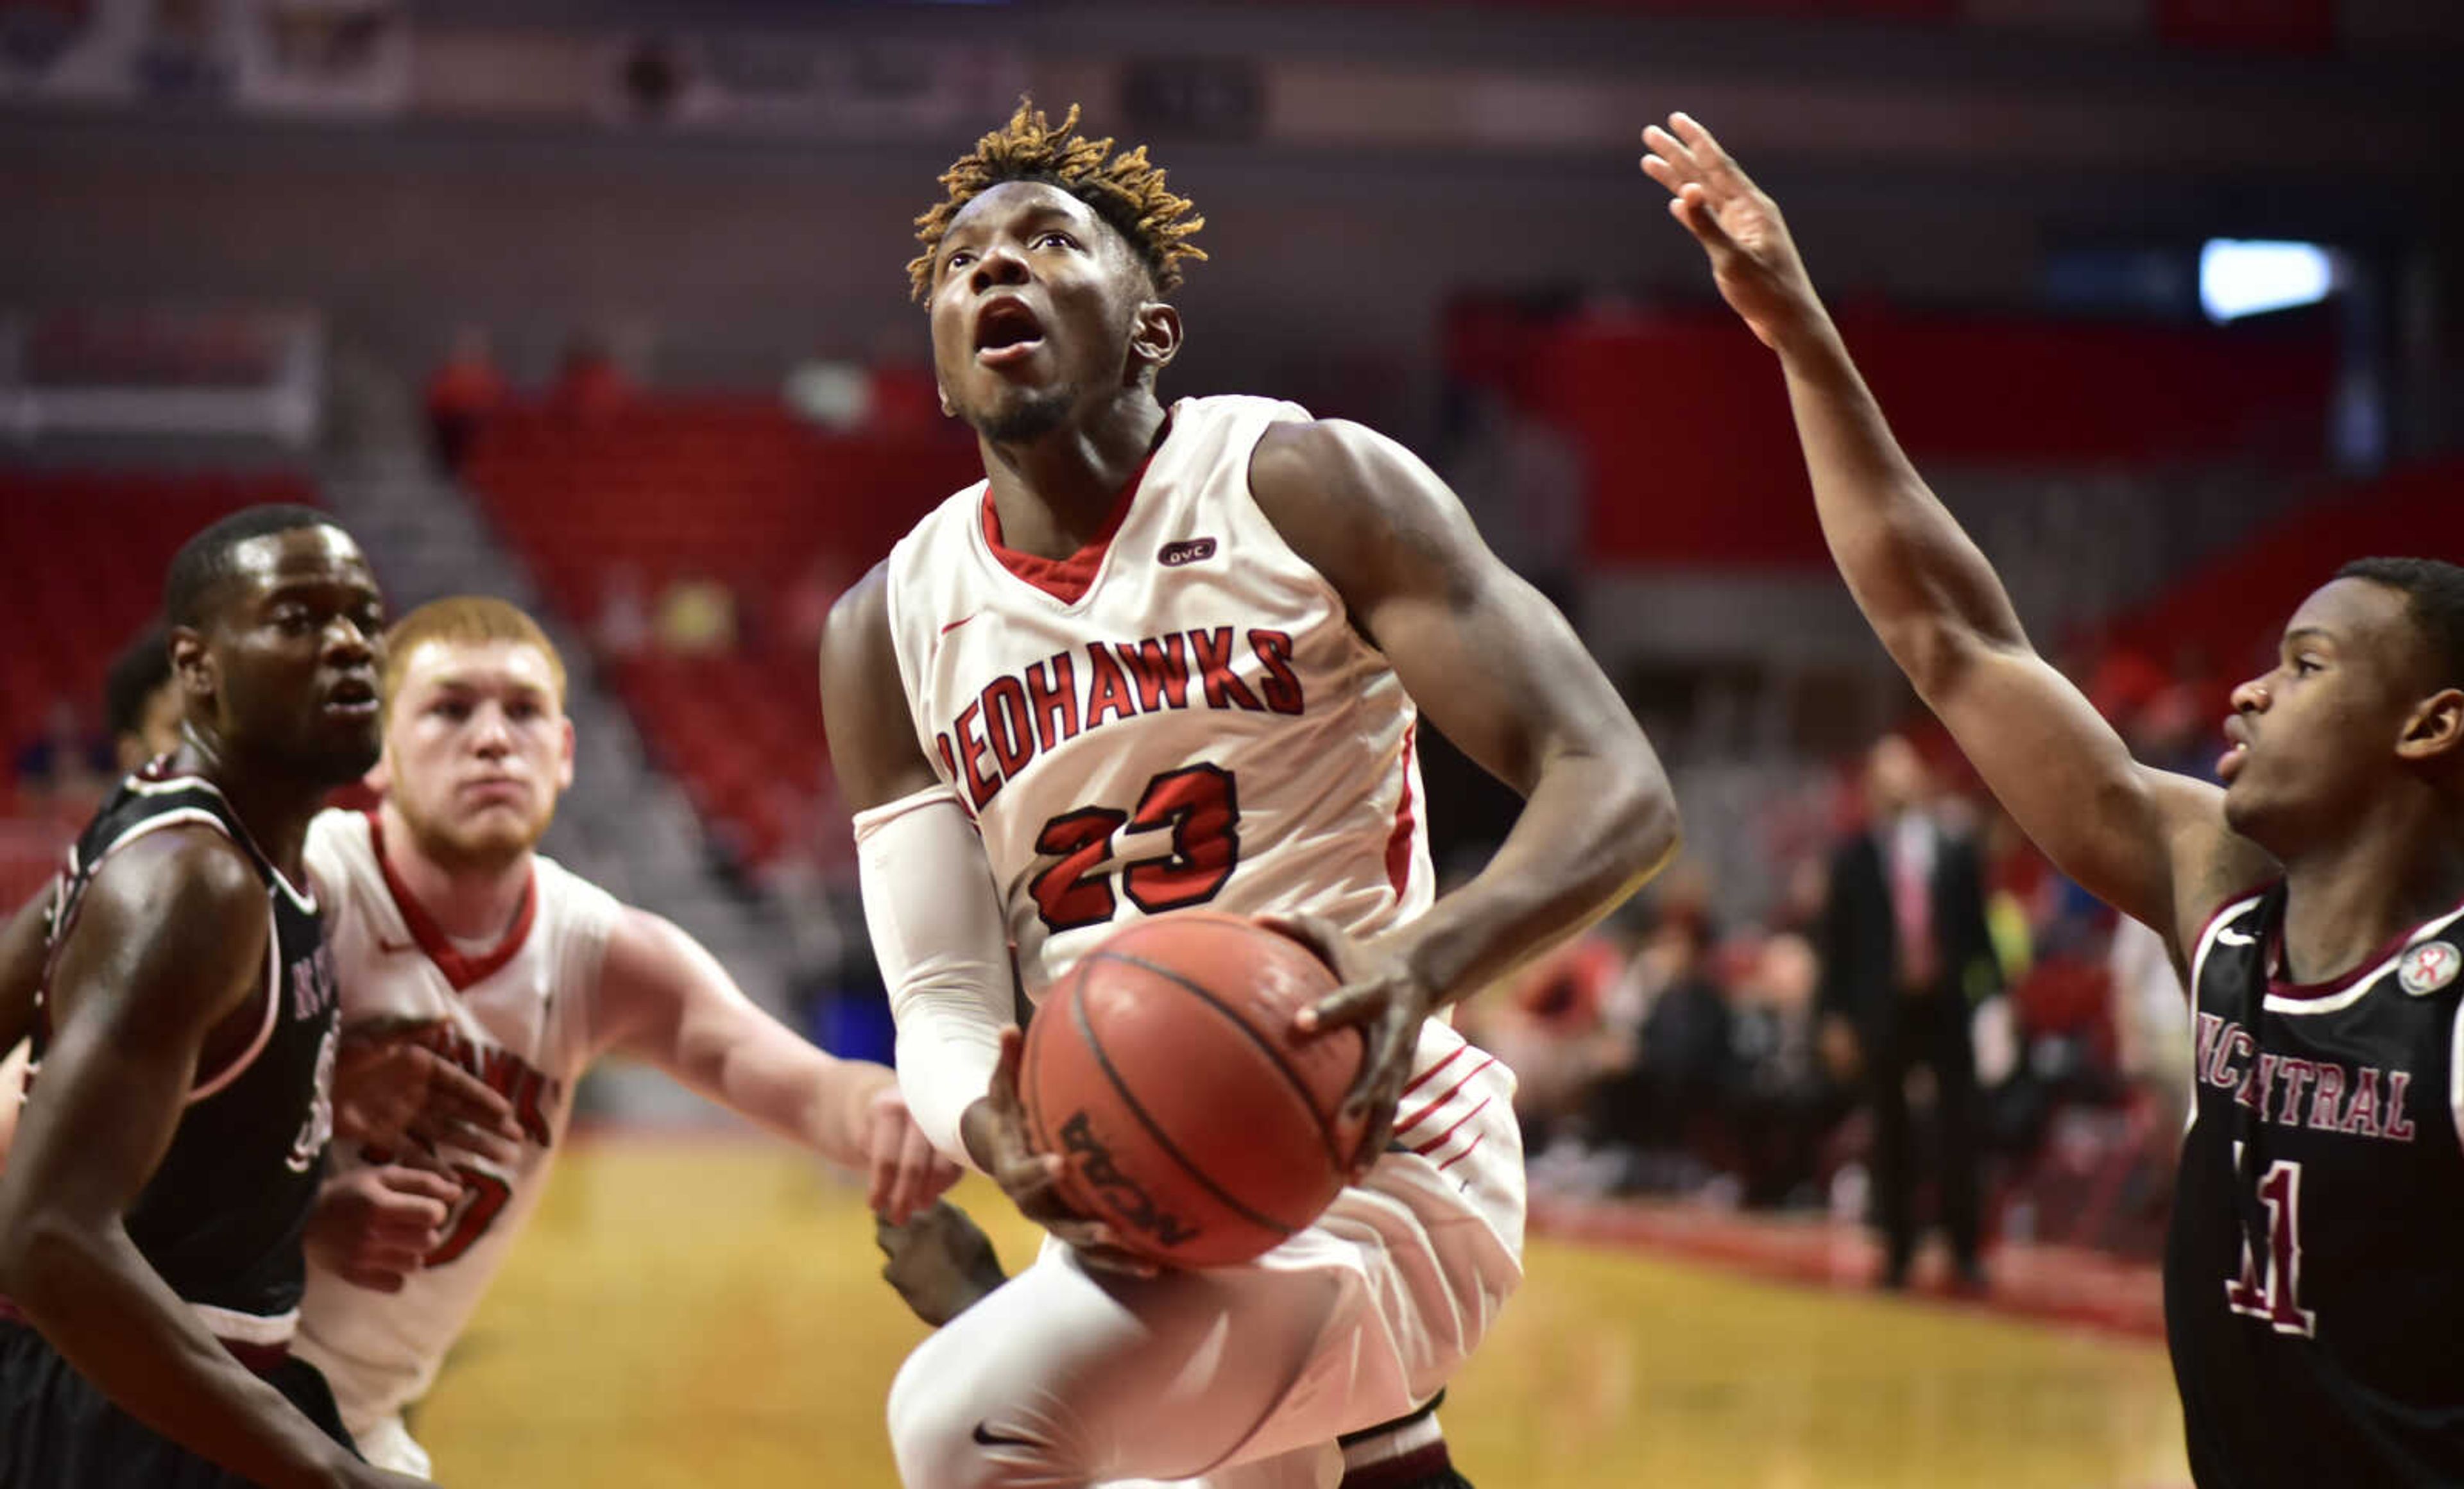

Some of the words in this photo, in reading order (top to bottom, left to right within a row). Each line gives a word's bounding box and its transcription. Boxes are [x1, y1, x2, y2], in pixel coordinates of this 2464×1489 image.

[1169, 545, 1204, 563] OVC
[1029, 761, 1240, 933] 23
[1059, 1108, 1203, 1247] NCAA
